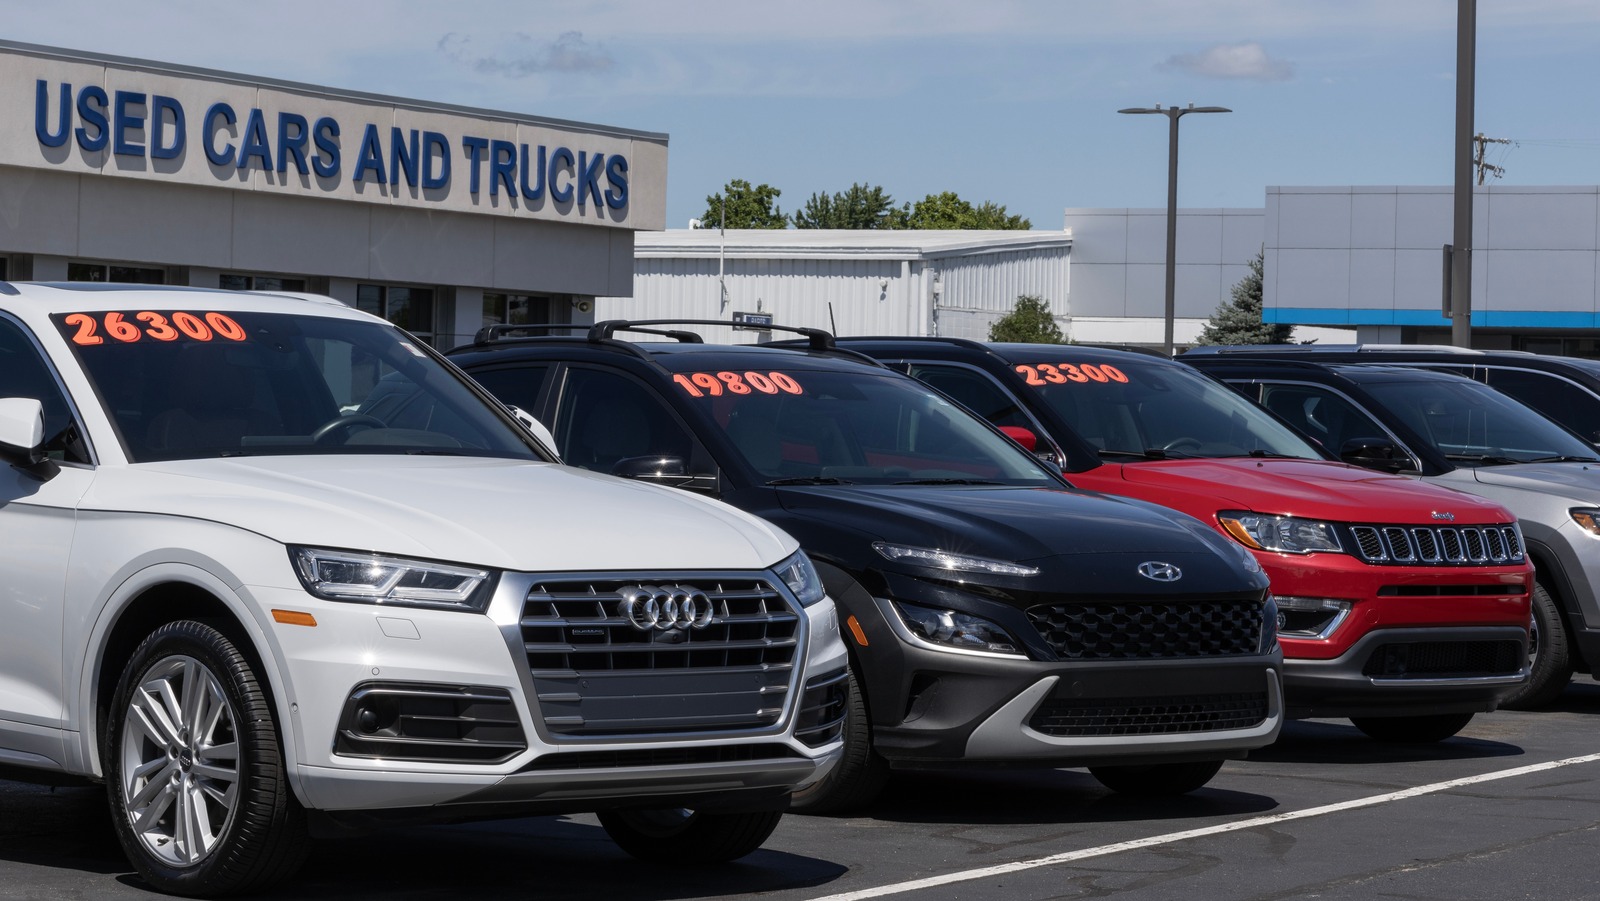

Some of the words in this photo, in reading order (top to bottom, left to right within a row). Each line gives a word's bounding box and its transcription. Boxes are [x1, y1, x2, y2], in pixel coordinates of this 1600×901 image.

[36, 79, 186, 160] USED
[203, 103, 341, 179] CARS
[354, 124, 452, 189] AND
[462, 136, 629, 210] TRUCKS
[65, 311, 247, 345] 26300
[673, 371, 803, 397] 19800
[1015, 363, 1129, 386] 23300
